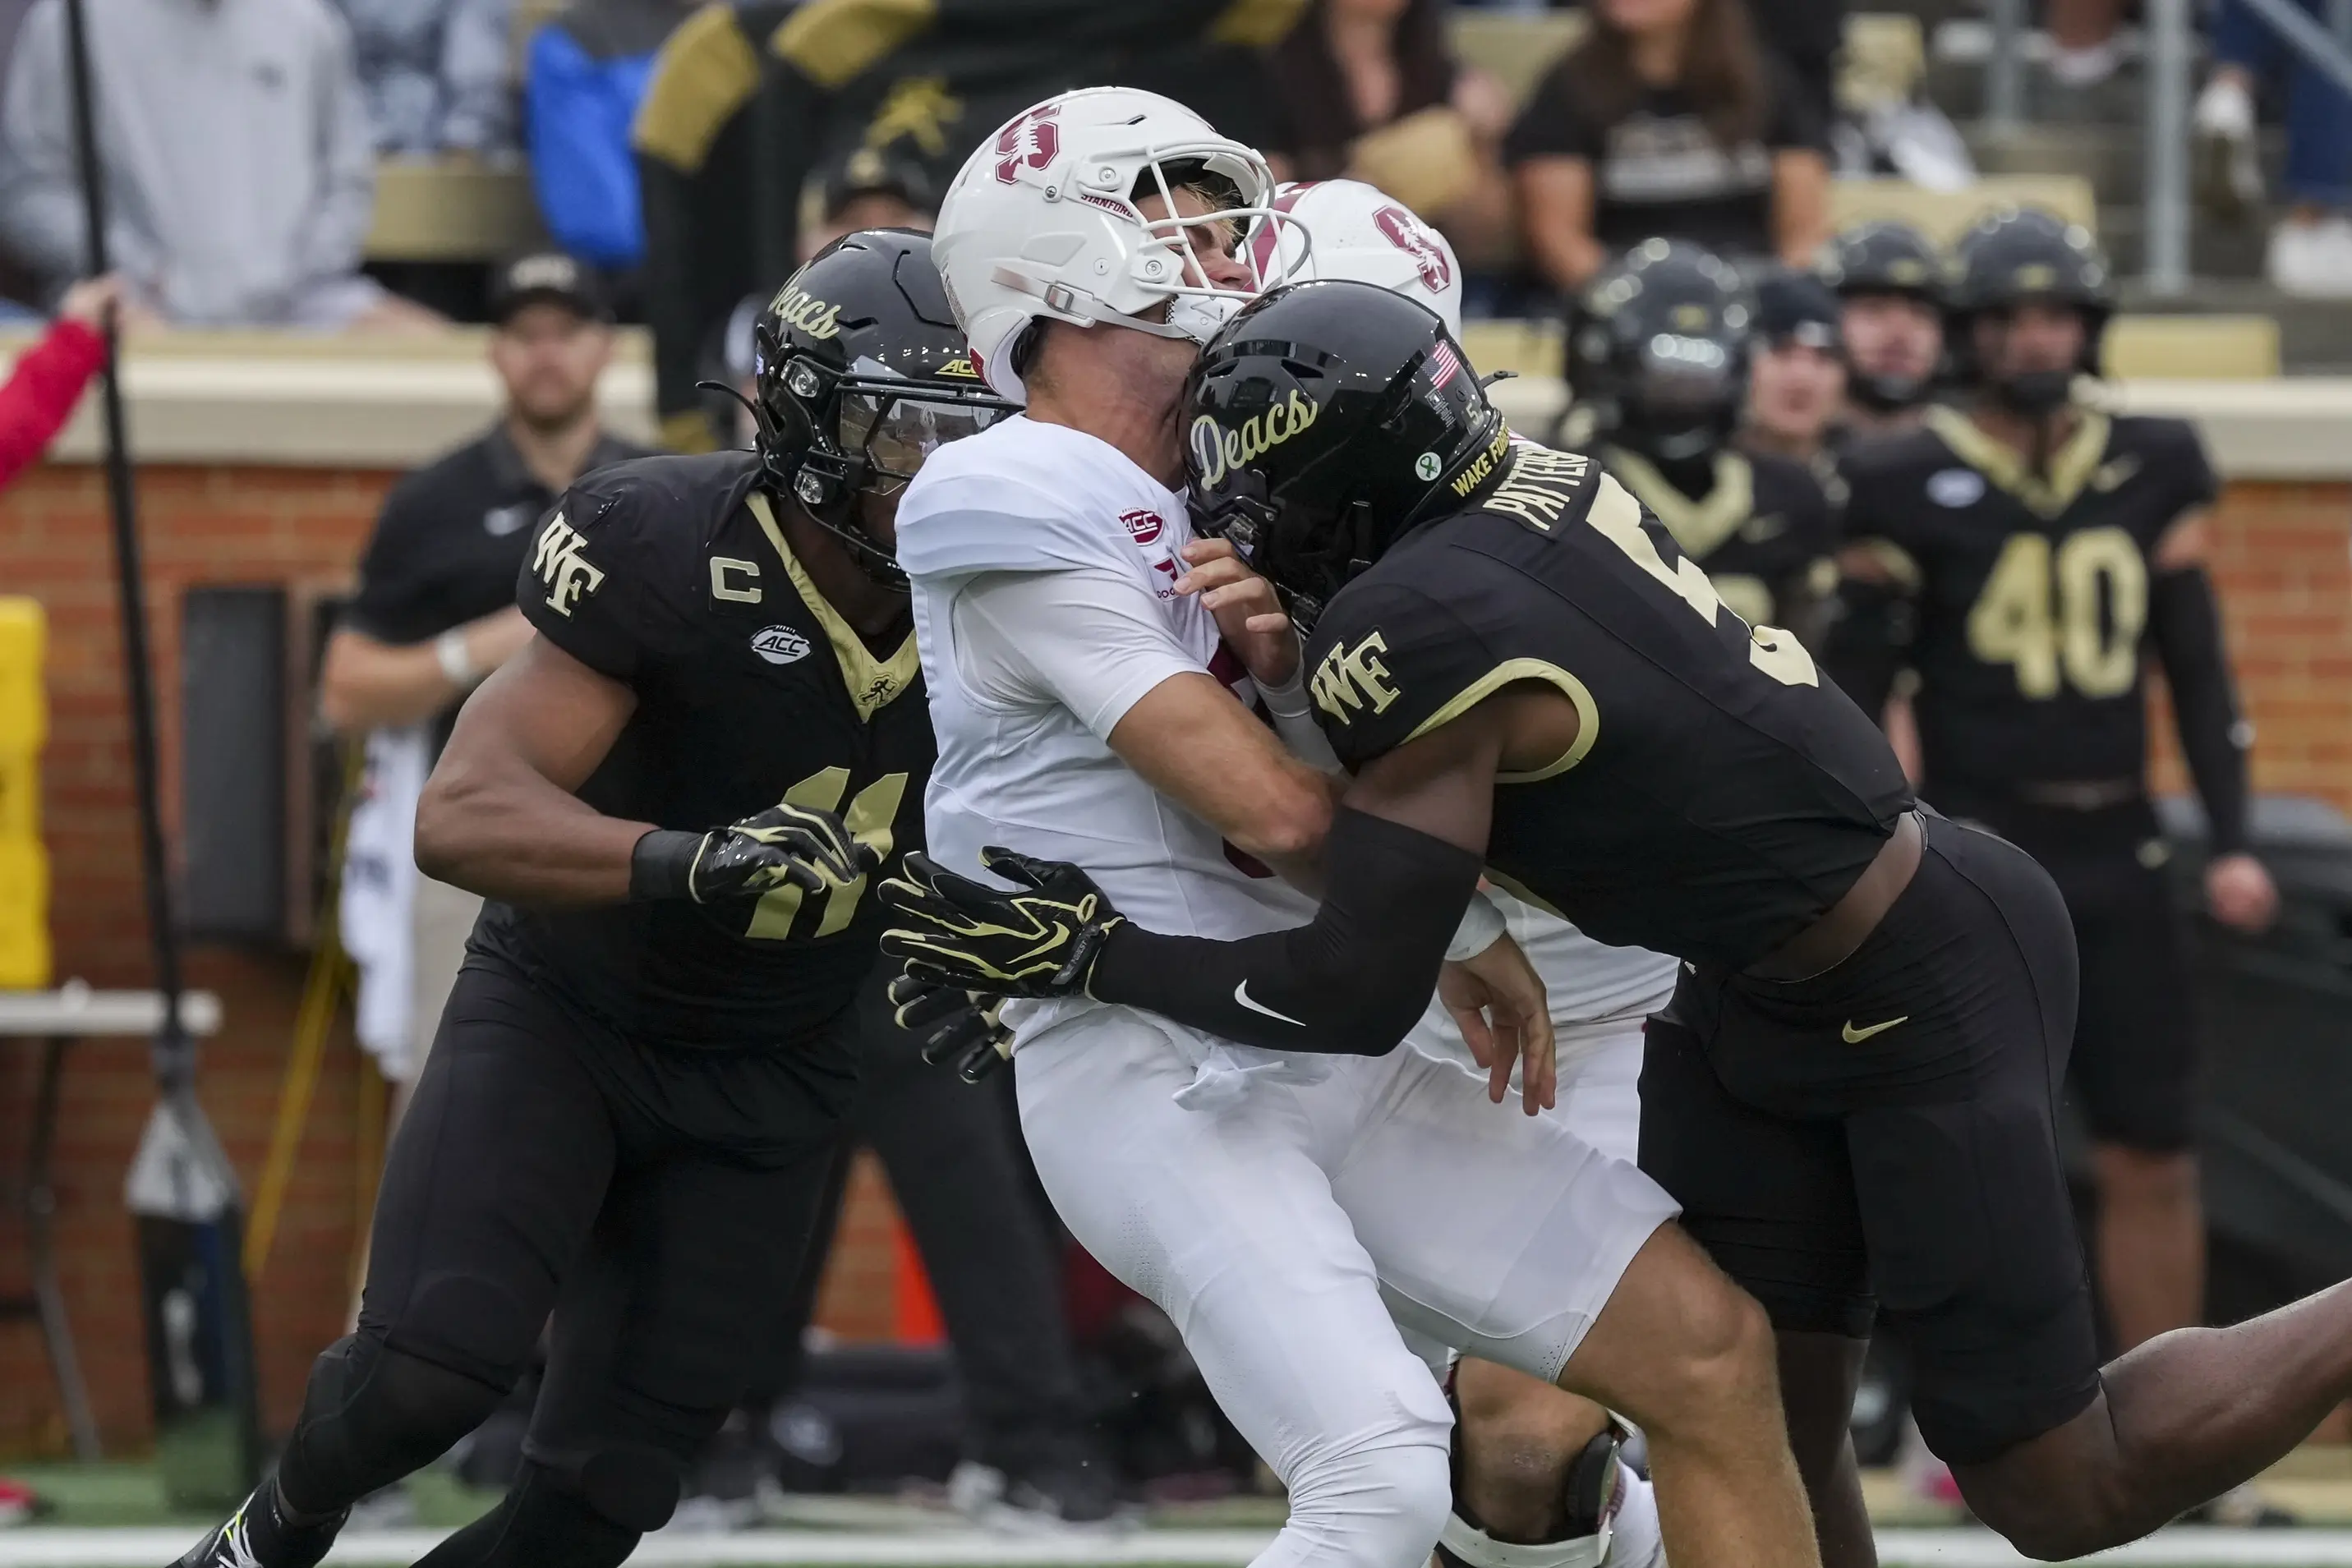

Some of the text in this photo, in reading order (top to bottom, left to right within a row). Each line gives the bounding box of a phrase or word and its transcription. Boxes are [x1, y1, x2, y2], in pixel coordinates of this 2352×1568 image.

[937, 358, 978, 374] AC
[1190, 389, 1319, 491] Deacs
[1451, 451, 1493, 498] WAKE
[1123, 512, 1158, 532] ACC
[532, 511, 605, 618] WF
[710, 556, 762, 604] C
[758, 635, 808, 654] ACC
[1965, 524, 2149, 701] 40
[1310, 631, 1401, 725] WF
[744, 766, 909, 939] 11
